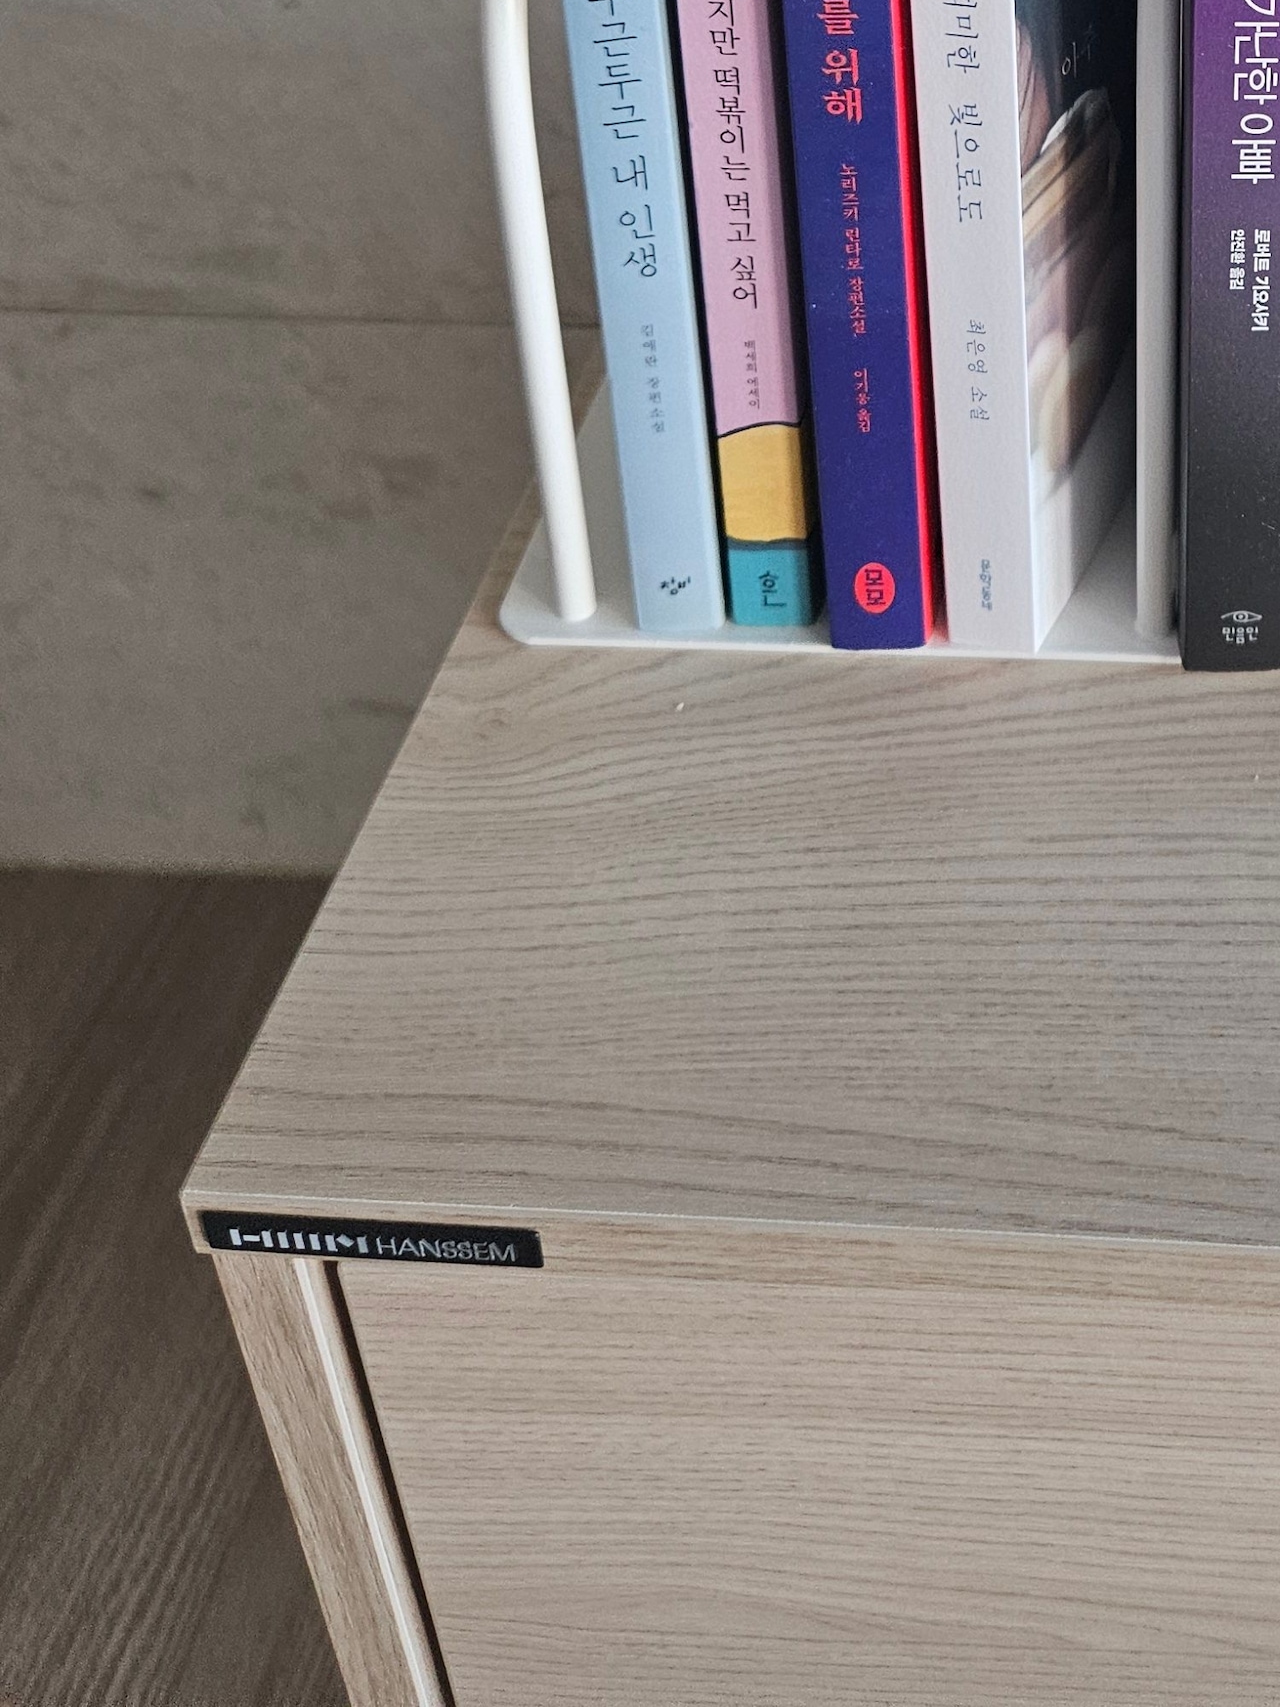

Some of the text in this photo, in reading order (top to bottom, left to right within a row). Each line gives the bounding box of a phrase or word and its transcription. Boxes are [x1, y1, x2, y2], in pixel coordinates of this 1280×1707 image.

[820, 47, 863, 124] 위해
[712, 66, 751, 182] 떡볶이는
[1231, 112, 1278, 185] 아빠
[612, 154, 649, 191] 내
[840, 163, 860, 222] 노리즈키
[948, 103, 983, 223] 빛으로도
[618, 203, 658, 278] 인생
[724, 191, 757, 243] 먹고
[730, 255, 759, 310] 싶어
[1229, 228, 1246, 291] 안진환 옮김
[1250, 228, 1272, 332] 로버트 기요사키
[848, 276, 867, 333] 장편소설
[966, 319, 990, 420] 최은영 소설
[864, 568, 887, 606] 모모
[1221, 625, 1259, 645] 민음인
[376, 1236, 517, 1263] HANSSEM
